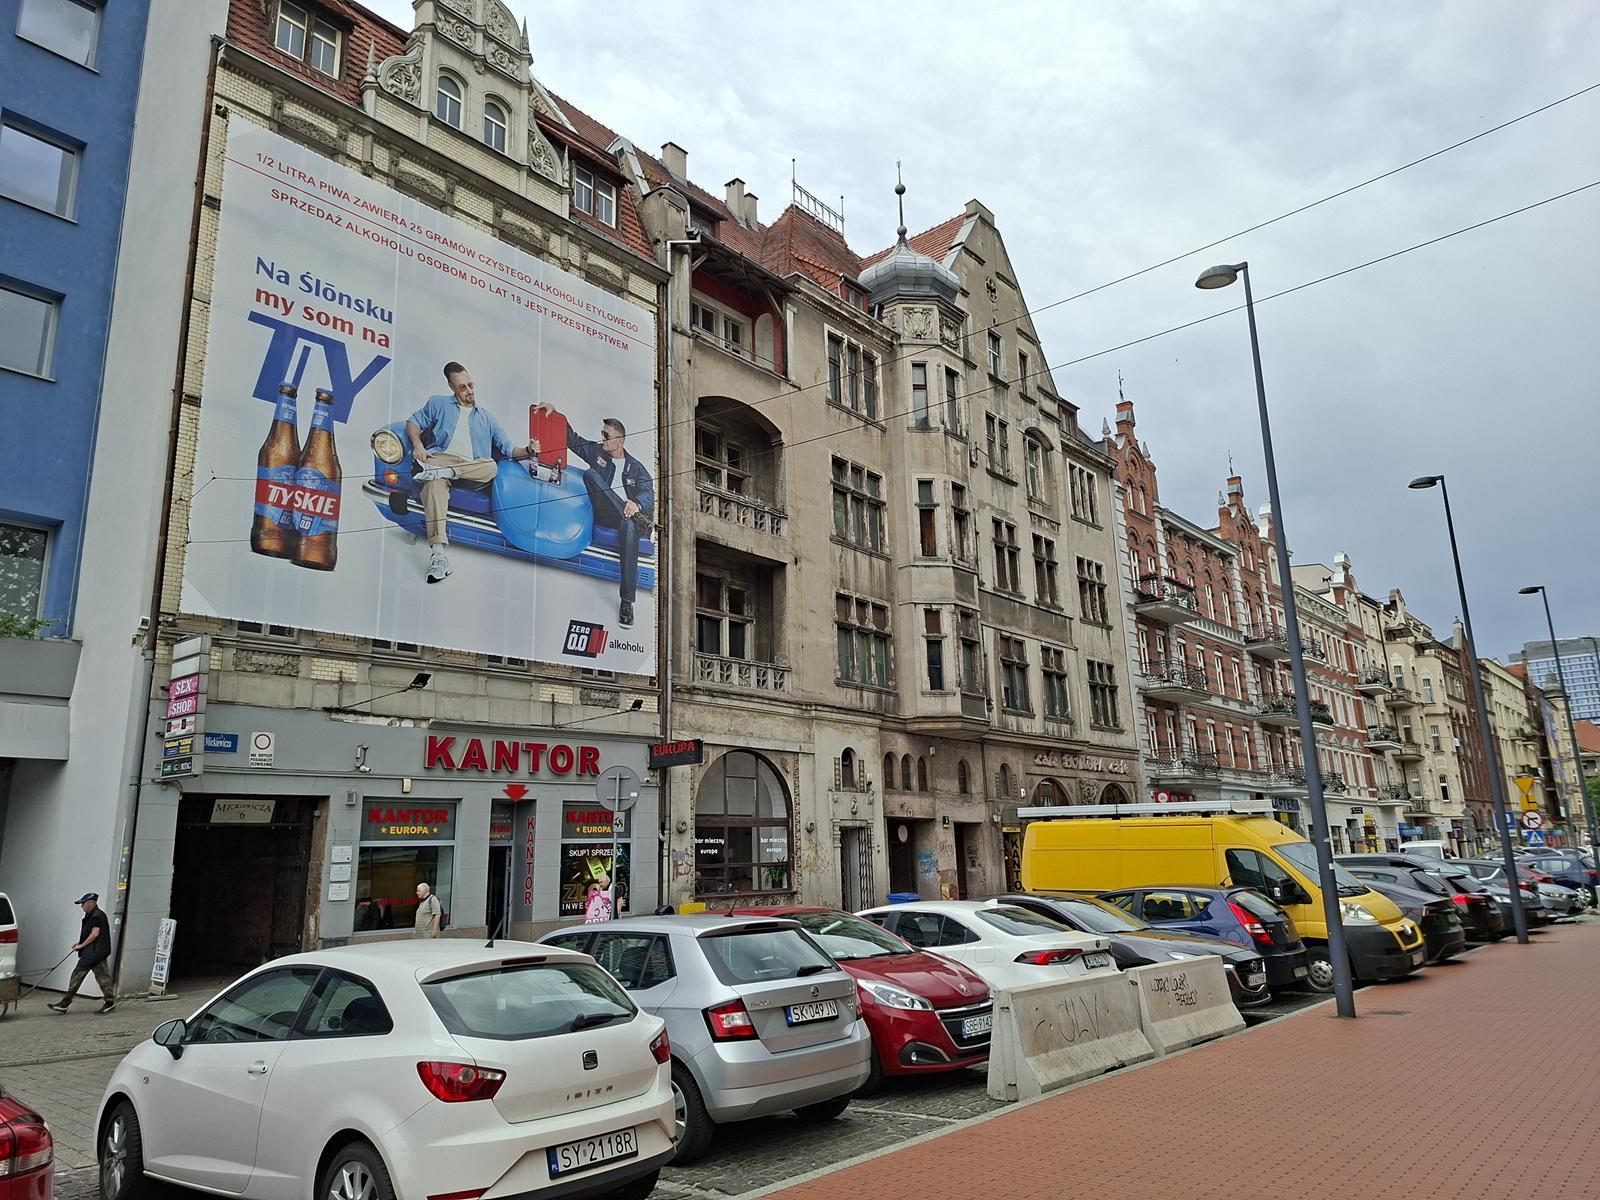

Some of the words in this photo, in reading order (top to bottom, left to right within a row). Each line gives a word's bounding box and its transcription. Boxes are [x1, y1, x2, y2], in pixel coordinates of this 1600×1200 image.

[256, 153, 274, 168] 1/2
[278, 162, 316, 187] LITRA
[319, 181, 351, 202] PIWA
[353, 196, 407, 228] ZAWIERA
[410, 222, 423, 235] 25
[425, 229, 475, 259] GRAMÓW
[478, 254, 531, 284] CZYSTEGO
[533, 279, 584, 308] ALKOHOLU
[586, 303, 639, 332] ETYLOWEGO
[271, 188, 343, 226] SPRZEDAŻ
[346, 221, 414, 257] ALKOHOLU
[417, 253, 467, 281] OSOBOM
[470, 275, 486, 288] DO
[489, 283, 508, 299] LAT
[511, 293, 522, 304] 18
[524, 299, 550, 316] JEST
[551, 310, 629, 351] PRZESTĘPSTWEM
[256, 256, 290, 286] Na
[299, 271, 393, 324] Ślōnsku
[255, 287, 295, 316] my
[302, 305, 354, 336] som
[362, 326, 390, 349] na
[267, 484, 337, 516] TYSKIE
[570, 624, 591, 635] ZERO
[567, 633, 588, 652] 0.0
[609, 639, 644, 653] alkoholu
[175, 679, 193, 695] SEX
[171, 699, 193, 715] SHOP
[424, 735, 600, 777] KANTOR
[653, 740, 695, 756] EUROPA
[215, 803, 272, 813] MICKIEWICZA
[240, 811, 246, 819] 6
[368, 808, 449, 824] KANTOR
[566, 810, 614, 824] KANTO
[389, 826, 429, 834] EUROPA
[582, 825, 612, 833] EUROPA
[704, 837, 725, 845] mleczny
[769, 837, 787, 845] mleczny
[524, 816, 535, 906] KANTOR
[569, 849, 586, 857] SKUP
[1010, 839, 1023, 891] KANTO
[793, 1004, 806, 1021] SK
[965, 1019, 978, 1032] SBE
[561, 1144, 581, 1168] SY
[587, 1132, 633, 1162] 2118R
